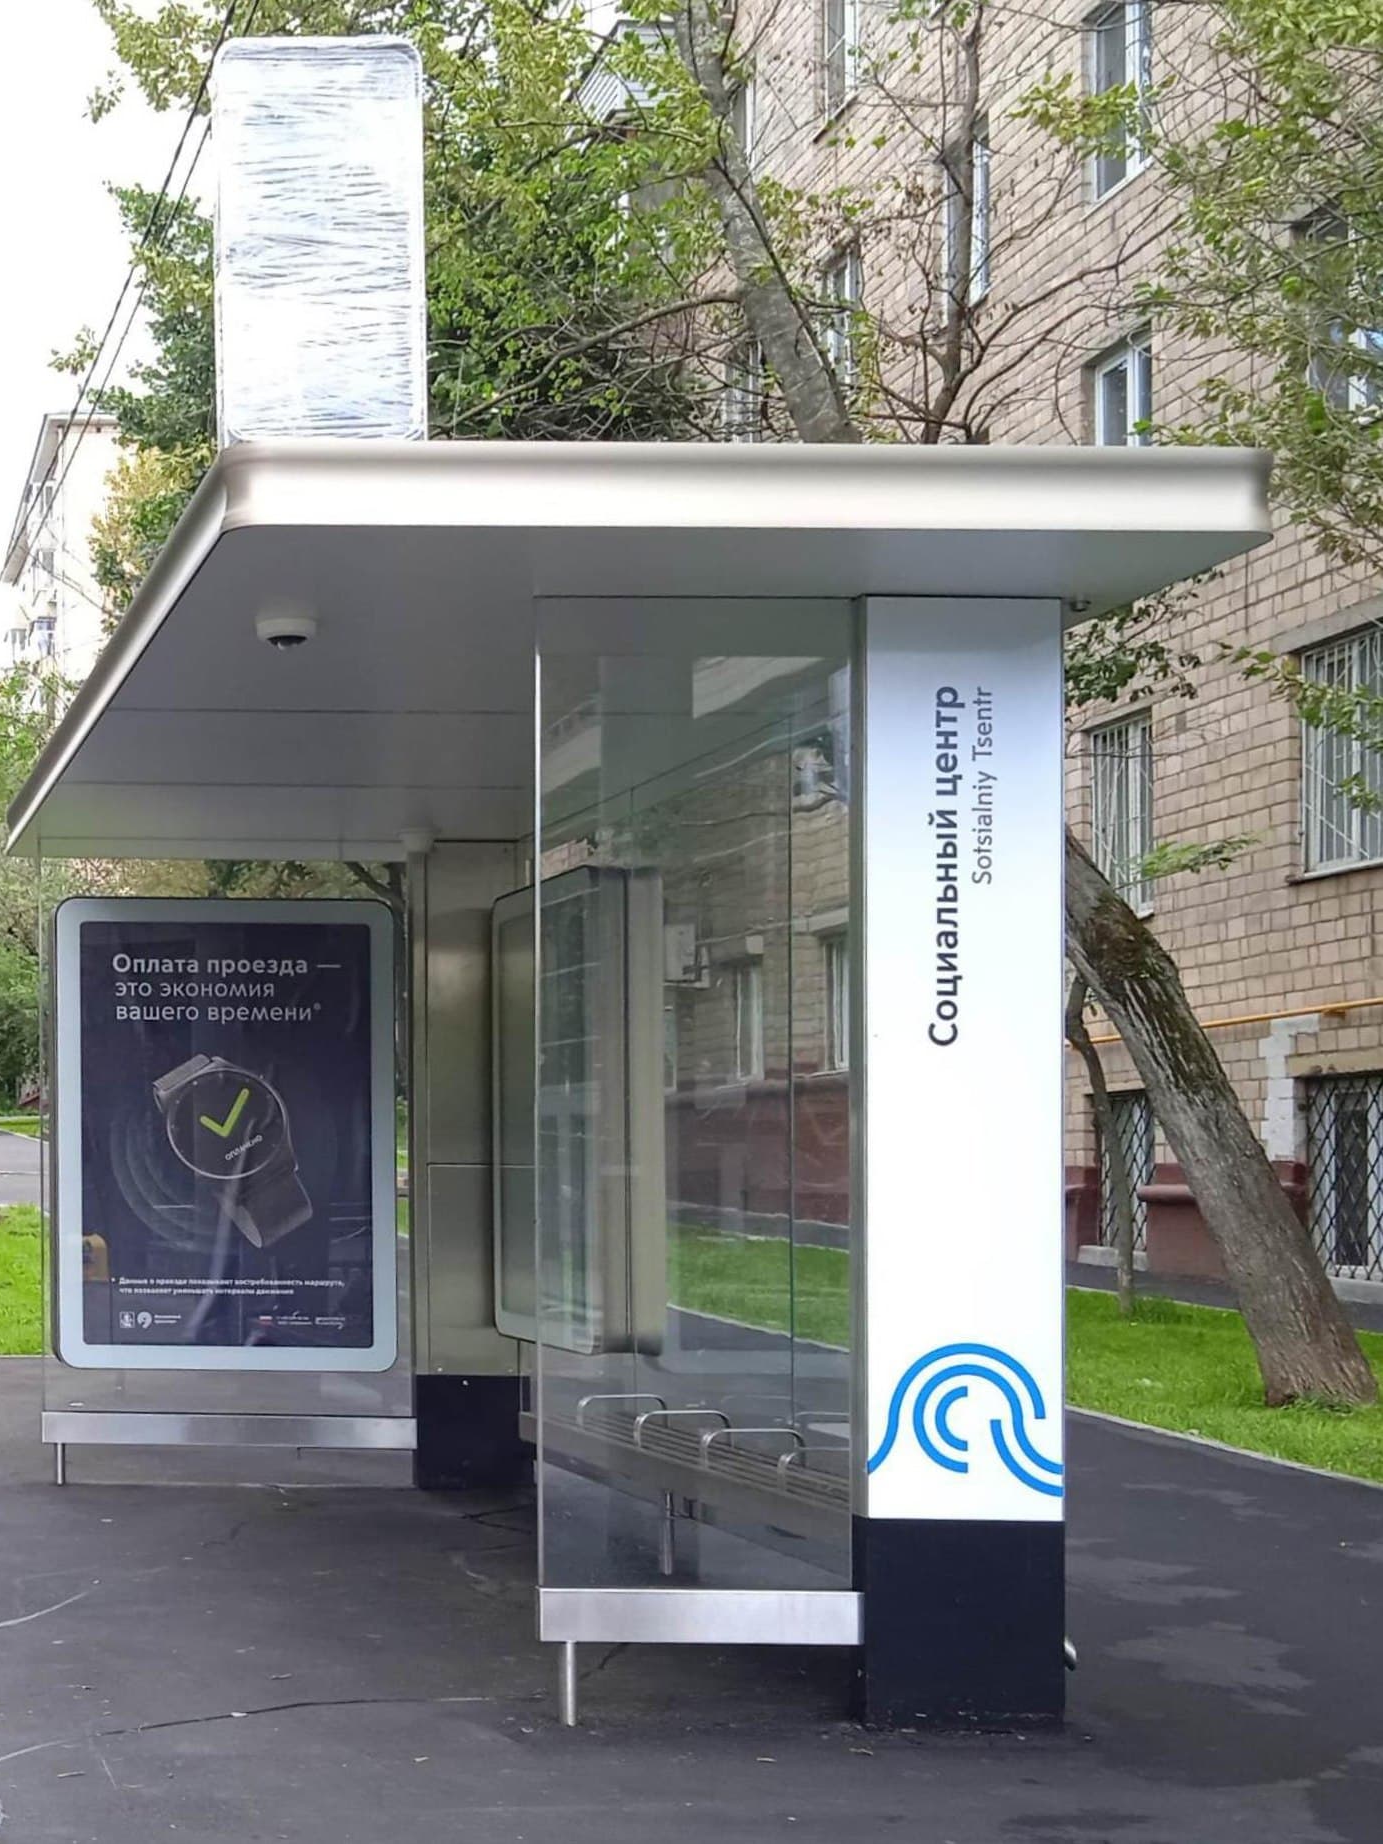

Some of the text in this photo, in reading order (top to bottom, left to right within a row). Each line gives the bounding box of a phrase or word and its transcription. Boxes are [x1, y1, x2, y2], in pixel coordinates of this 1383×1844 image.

[971, 686, 997, 885] Sotsialniy Tsentr
[928, 685, 965, 1047] Социальный центр
[112, 953, 199, 973] Оплата
[207, 958, 308, 977] проезда
[115, 982, 275, 997] это экономия
[116, 1005, 199, 1021] вашего
